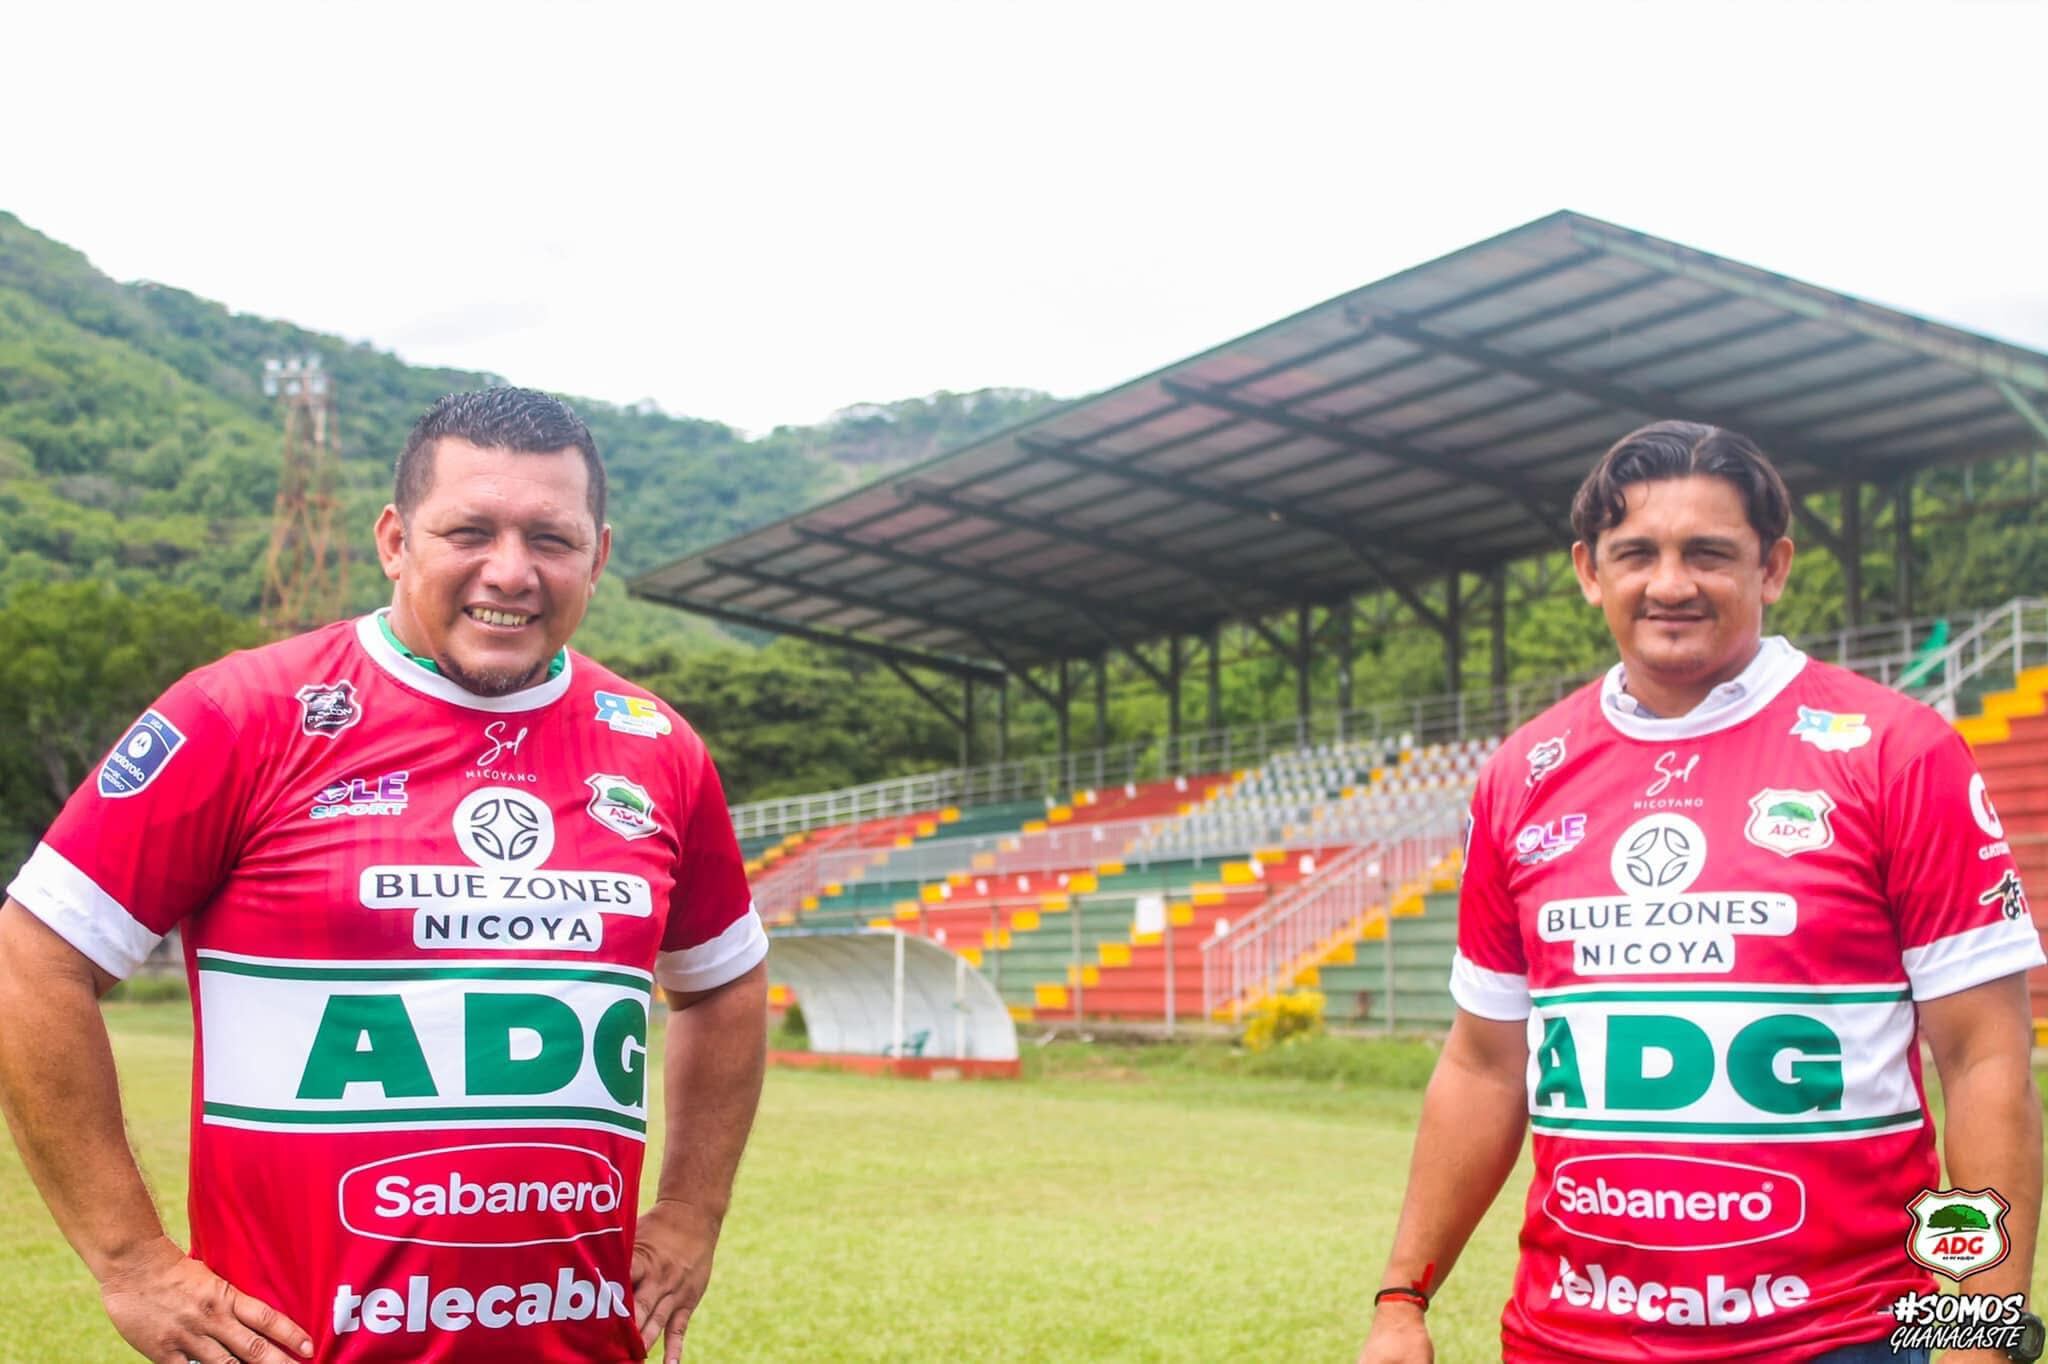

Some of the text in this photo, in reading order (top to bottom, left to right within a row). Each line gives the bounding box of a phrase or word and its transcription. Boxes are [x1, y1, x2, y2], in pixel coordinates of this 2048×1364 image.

[477, 721, 528, 767] Sol
[465, 769, 537, 783] NICOYANO
[1646, 751, 1700, 797] Sol
[309, 803, 408, 819] SPORT
[1633, 797, 1704, 810] NICOYANO
[1768, 823, 1811, 839] ADG
[375, 873, 488, 899] BLUE
[425, 914, 593, 943] NICOYA
[1547, 903, 1632, 932] BLUE
[1581, 941, 1724, 966] NICOYA
[296, 992, 648, 1108] ADG
[1535, 1014, 1844, 1115] ADG
[374, 1171, 620, 1218] Sabanero
